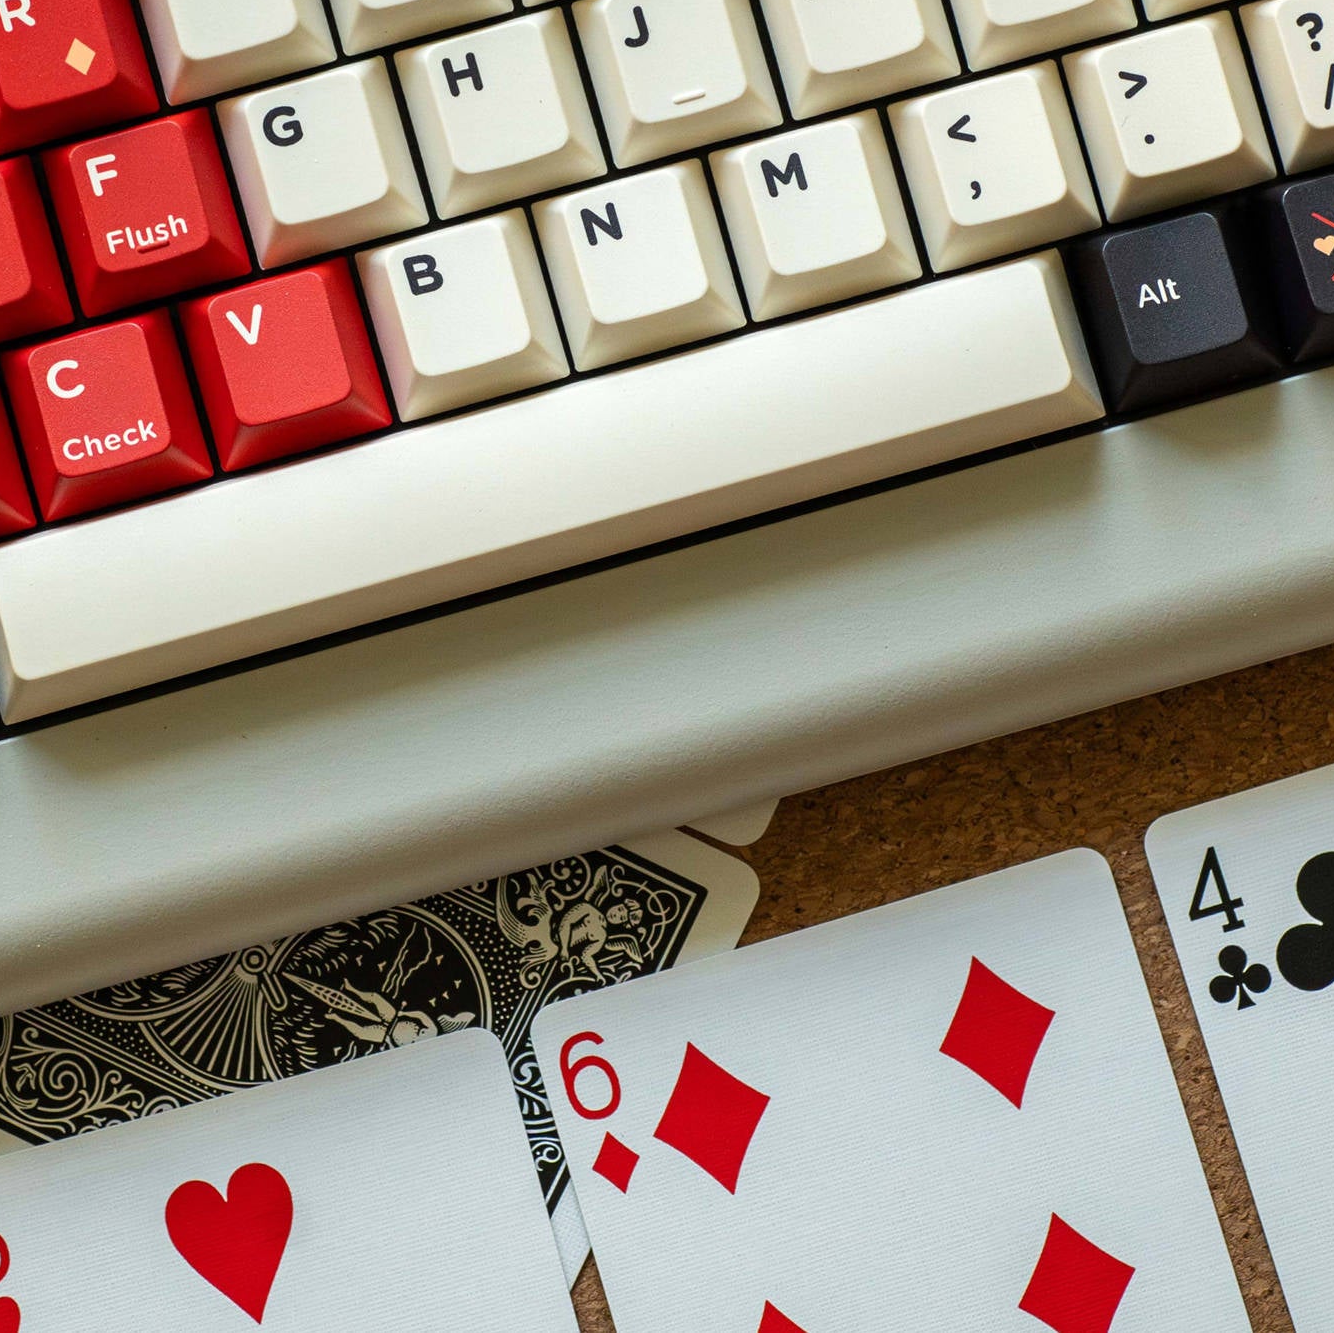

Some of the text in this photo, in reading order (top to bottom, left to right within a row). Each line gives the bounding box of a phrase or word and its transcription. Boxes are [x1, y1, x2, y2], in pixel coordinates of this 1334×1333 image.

[624, 5, 650, 48] J
[1296, 12, 1323, 52] ?
[441, 52, 484, 97] H
[262, 105, 304, 147] G
[85, 154, 118, 197] F
[761, 152, 808, 198] M
[106, 214, 188, 254] Flush
[579, 202, 624, 246] N
[403, 253, 444, 296] B
[1138, 278, 1181, 309] Alt
[225, 303, 262, 345] V
[46, 359, 86, 399] C
[62, 419, 157, 461] Check
[1189, 846, 1245, 933] 4
[559, 1031, 621, 1121] 6
